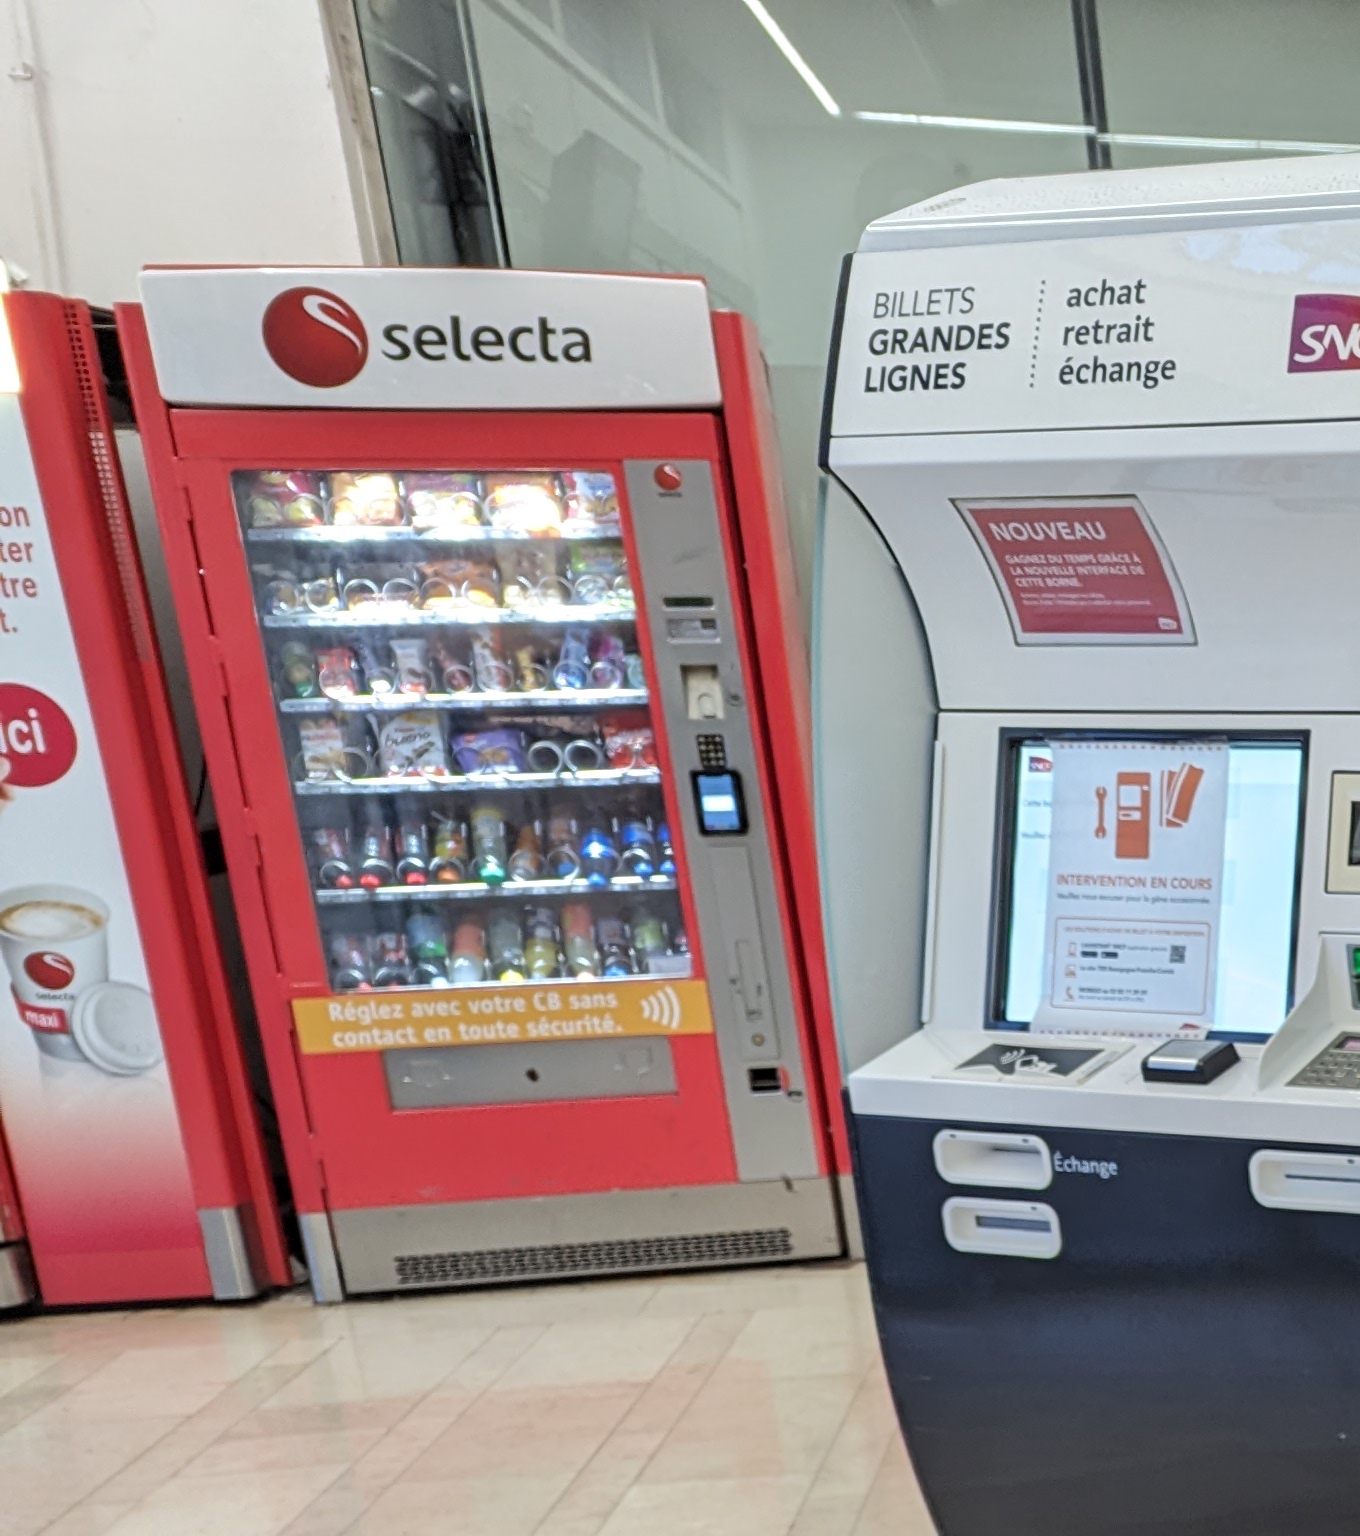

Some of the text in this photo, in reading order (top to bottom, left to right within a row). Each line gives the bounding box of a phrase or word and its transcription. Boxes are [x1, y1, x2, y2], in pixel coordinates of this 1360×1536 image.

[872, 286, 976, 319] BILLETS
[1065, 279, 1147, 308] achat
[381, 316, 592, 364] selecta
[867, 321, 1012, 356] GRANDES
[1062, 314, 1156, 347] retrait
[863, 361, 967, 393] LIGNES
[1058, 355, 1177, 389] échange
[988, 521, 1107, 541] NOUVEAU
[1010, 565, 1145, 576] LA NOUVELLE INTERFACE DE
[1047, 554, 1063, 564] DU
[1064, 554, 1097, 564] TEMPS
[1015, 577, 1045, 587] CETTE
[0, 708, 47, 754] ci
[1056, 874, 1213, 890] INTERVENTION EN COURS
[328, 991, 618, 1026] Réglez avec votre CB sans
[332, 1013, 625, 1048] contact en toute sécurité.
[1053, 1150, 1118, 1179] Échange
